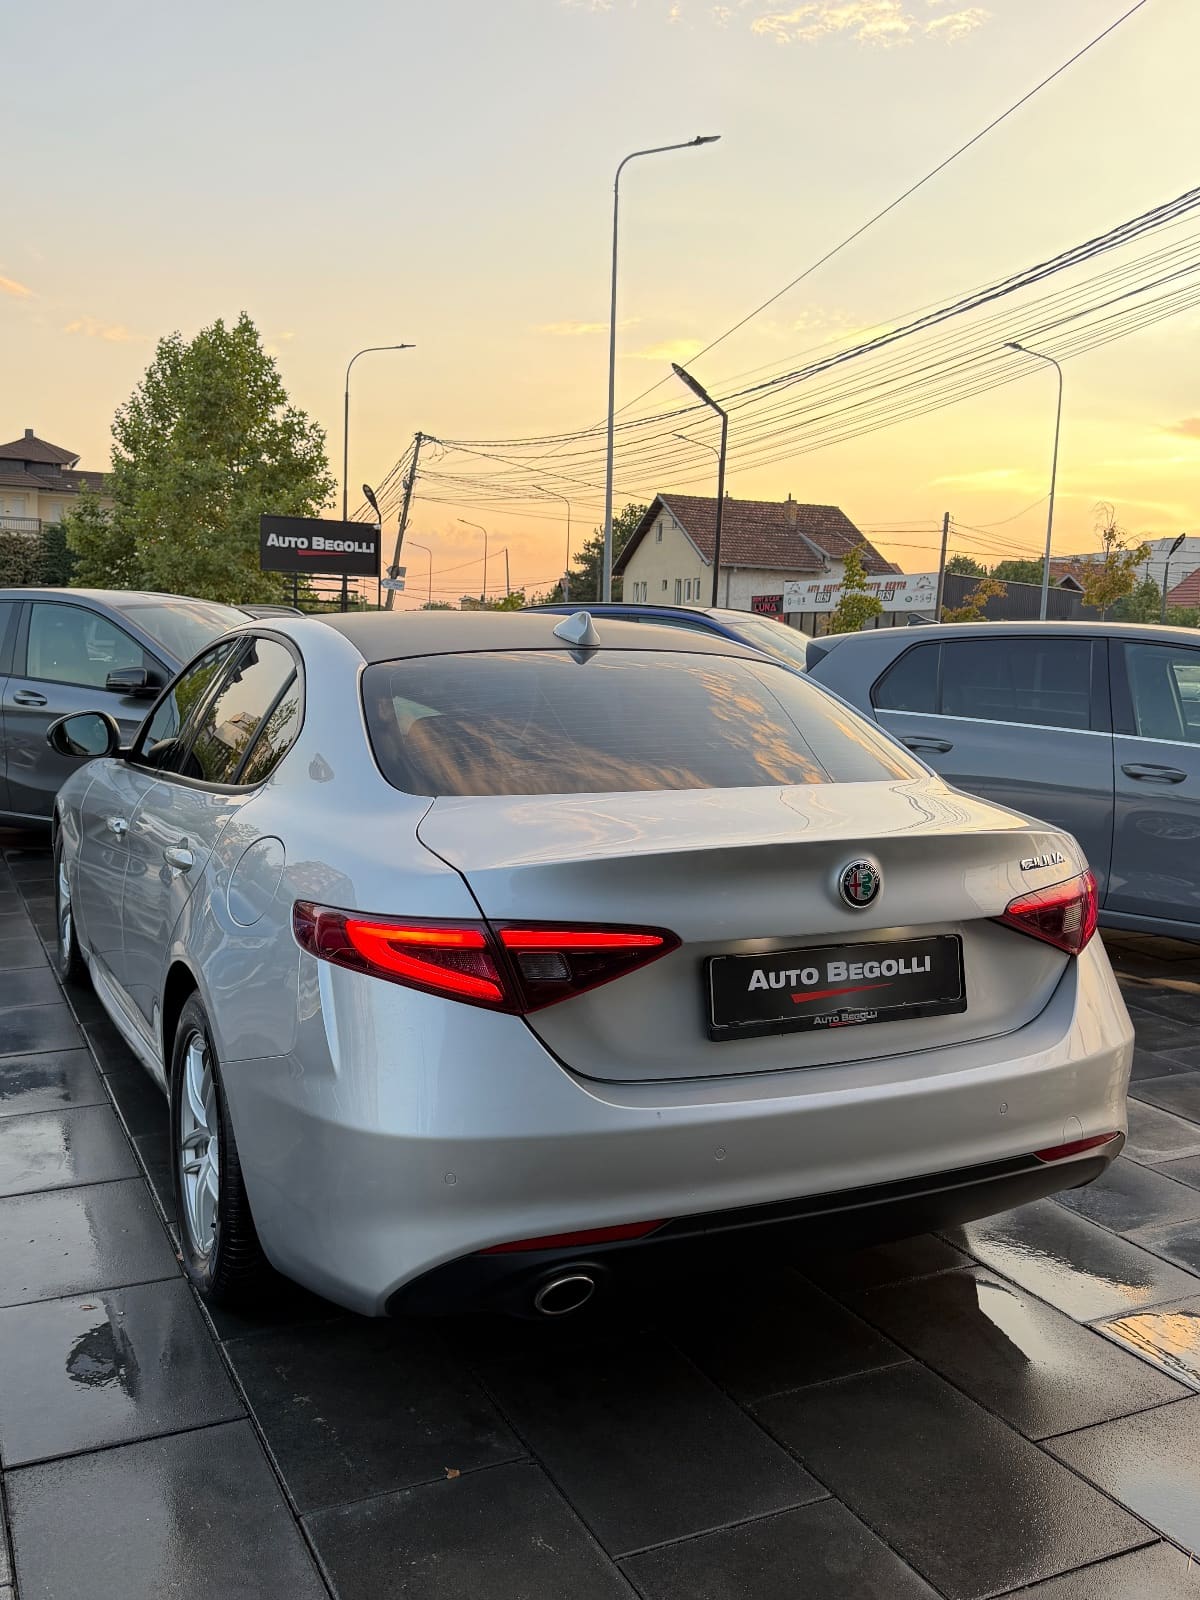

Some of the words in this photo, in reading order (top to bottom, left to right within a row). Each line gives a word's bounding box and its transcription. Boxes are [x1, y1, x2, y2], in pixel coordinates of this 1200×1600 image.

[266, 533, 309, 549] AUTO
[311, 536, 375, 553] BEGOLLI
[754, 603, 777, 612] LUNA
[1019, 852, 1065, 871] GIULIA
[747, 967, 819, 992] AUTO
[826, 955, 931, 983] BEGOLLI
[813, 1016, 840, 1025] AUTO
[841, 1011, 878, 1022] BEGOLLI
